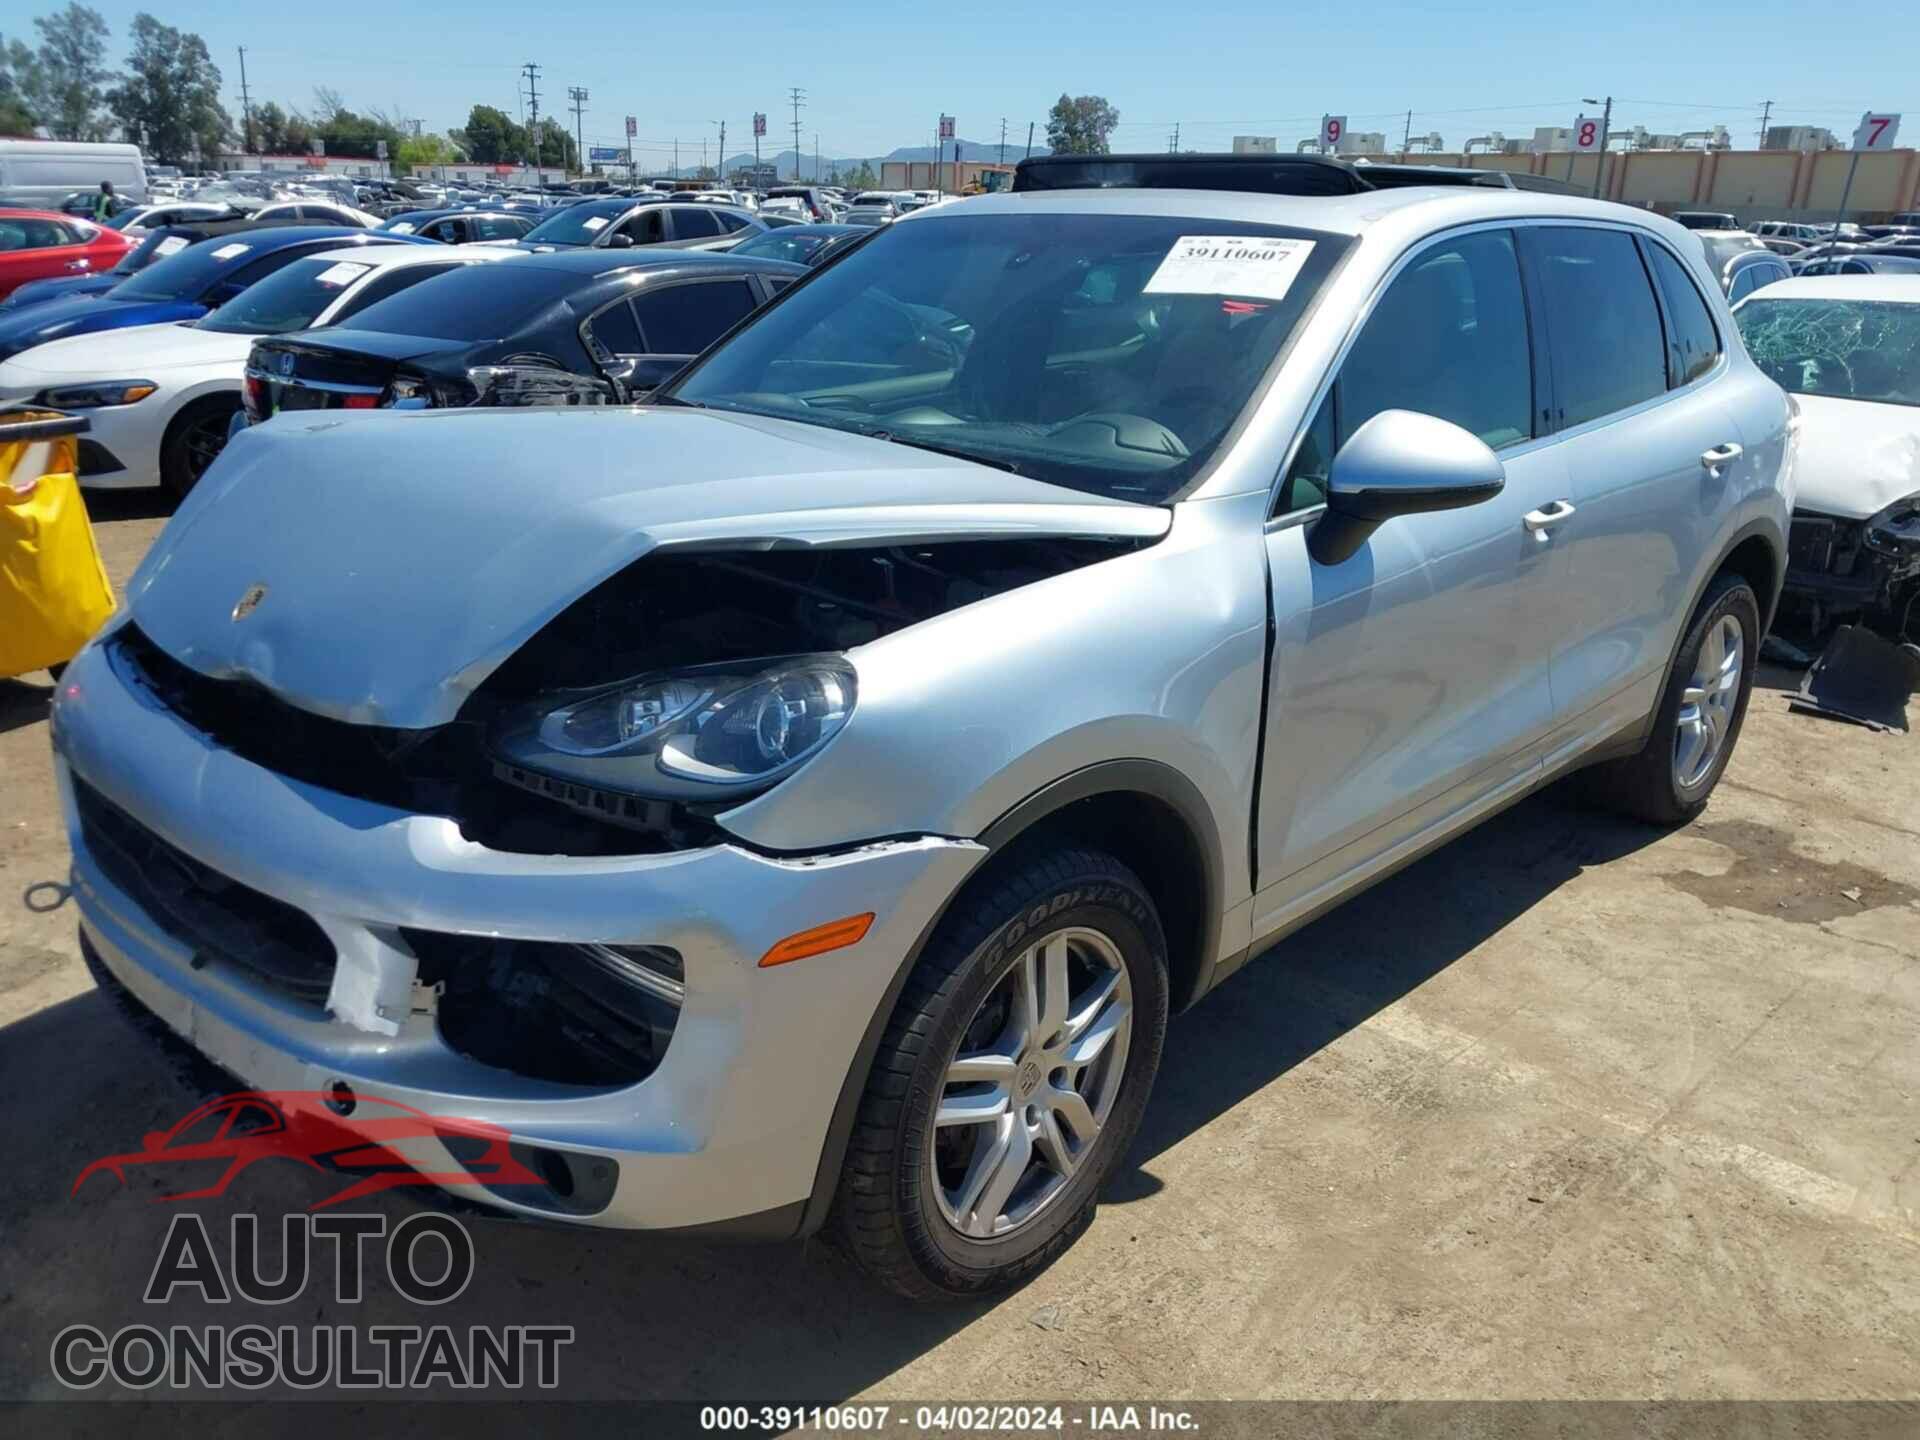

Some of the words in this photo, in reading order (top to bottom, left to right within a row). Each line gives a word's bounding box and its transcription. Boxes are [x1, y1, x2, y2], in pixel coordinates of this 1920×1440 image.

[754, 117, 767, 133] 12
[940, 121, 954, 137] 11
[1328, 120, 1340, 142] 9
[1579, 122, 1596, 147] 8
[1867, 119, 1890, 147] 7
[1180, 246, 1292, 262] 39110607
[983, 884, 1147, 976] GOODYEAR
